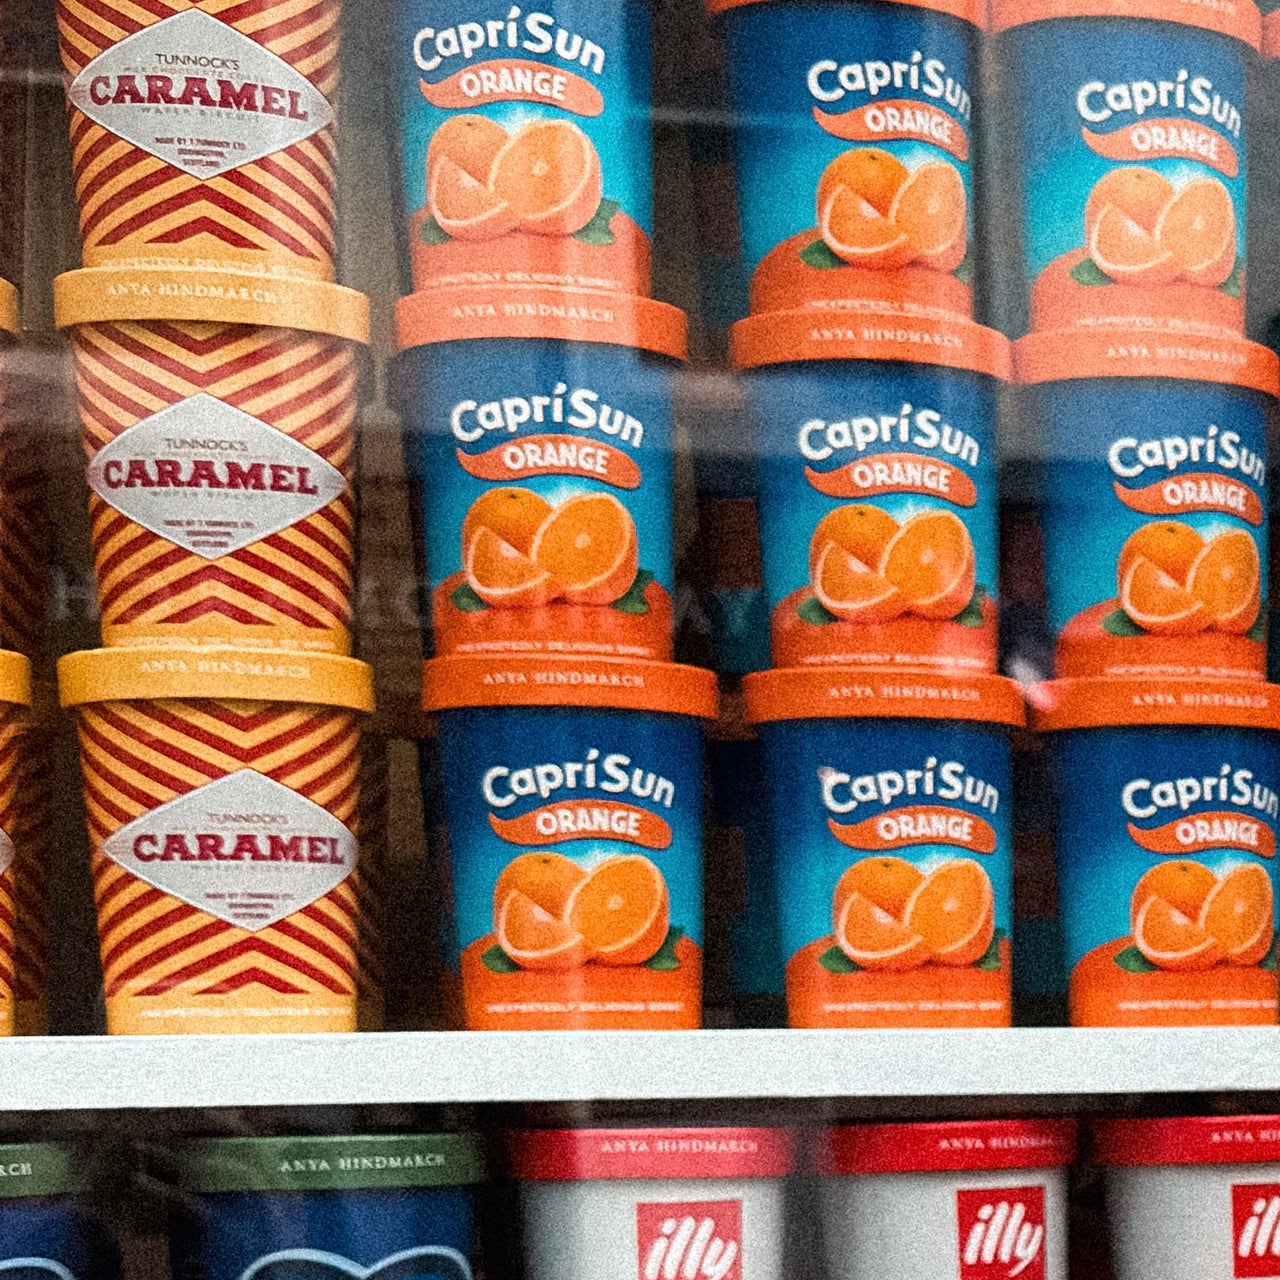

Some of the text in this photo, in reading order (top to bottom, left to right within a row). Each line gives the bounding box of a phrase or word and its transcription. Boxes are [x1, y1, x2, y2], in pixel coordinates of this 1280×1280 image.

[89, 75, 308, 121] CARAMEL
[459, 71, 568, 102] ORANGE
[864, 106, 953, 145] ORANGE
[1130, 125, 1220, 160] ORANGE
[500, 439, 609, 475] ORANGE
[103, 458, 319, 496] CARAMEL
[851, 460, 952, 493] ORANGE
[1162, 480, 1248, 513] ORANGE
[535, 808, 643, 838] ORANGE
[877, 814, 974, 842] ORANGE
[1175, 821, 1261, 847] ORANGE
[132, 833, 346, 865] CARAMEL
[279, 1153, 445, 1173] ANYA HINDMARCH
[963, 1200, 1044, 1277] illy
